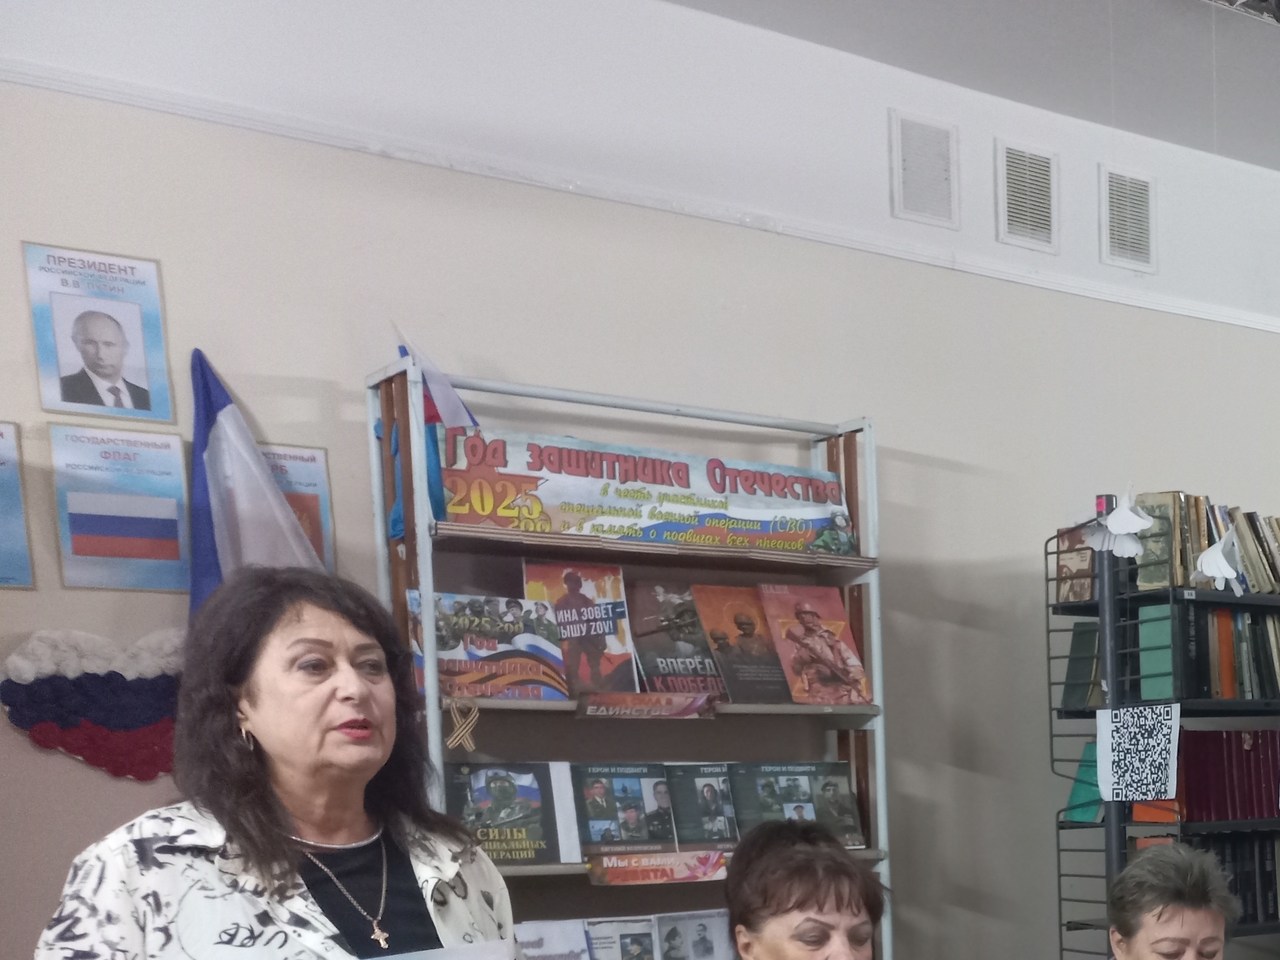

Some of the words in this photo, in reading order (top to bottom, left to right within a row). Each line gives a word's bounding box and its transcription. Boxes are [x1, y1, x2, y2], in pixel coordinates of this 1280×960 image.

[46, 254, 137, 276] ПРЕЗИДЕНТ
[87, 281, 125, 294] ПУТИН
[64, 434, 171, 450] ГОСУДАРСТВЕННЫЙ
[445, 426, 508, 469] Год
[706, 458, 843, 506] Отечества
[444, 476, 544, 519] 2025
[615, 487, 652, 500] честь
[560, 501, 643, 519] специальной
[647, 506, 700, 526] военной
[705, 516, 762, 531] операции
[769, 515, 813, 538] (СВО)
[590, 523, 643, 538] память
[650, 529, 656, 539] о
[663, 530, 721, 545] подвигах
[756, 533, 804, 551] предков
[581, 604, 613, 621] ЗОВЁТ
[451, 616, 491, 632] 2025
[496, 620, 524, 634] год
[590, 621, 614, 636] ZOV!
[463, 633, 498, 651] Год
[656, 657, 718, 676] ВПЕРЁД
[653, 676, 664, 692] К
[586, 706, 671, 716] ЕДИНСТВЕ
[476, 827, 527, 840] СИЛЫ
